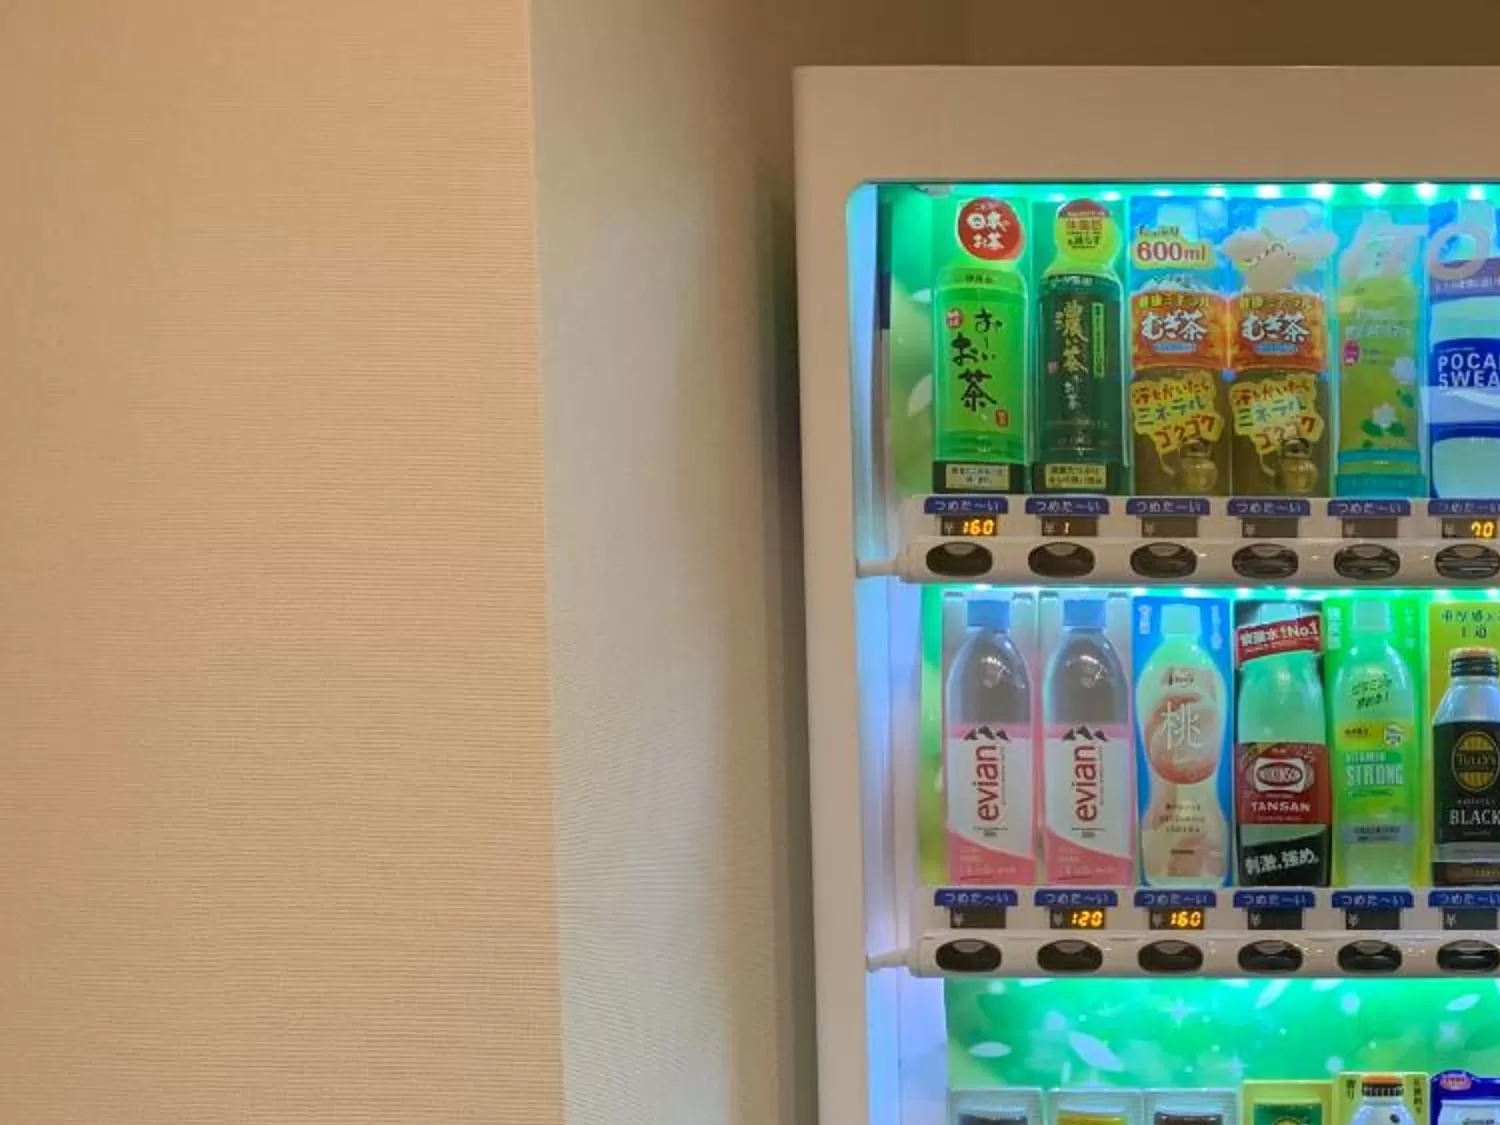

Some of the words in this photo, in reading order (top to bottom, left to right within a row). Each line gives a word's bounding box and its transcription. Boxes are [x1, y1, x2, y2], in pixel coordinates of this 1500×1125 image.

[1137, 241, 1206, 262] 600ml
[1141, 309, 1208, 342] むぎ茶
[1241, 310, 1311, 343] むぎ茶
[951, 332, 998, 413] お茶
[1137, 394, 1206, 428] ミネラル
[960, 519, 994, 536] 160
[1160, 700, 1201, 751] 桃
[972, 745, 999, 822] evian
[1071, 744, 1098, 822] evian
[1345, 764, 1404, 786] STRONG
[1251, 801, 1312, 813] TANSAN
[1071, 911, 1103, 928] 120
[1170, 911, 1202, 928] 160
